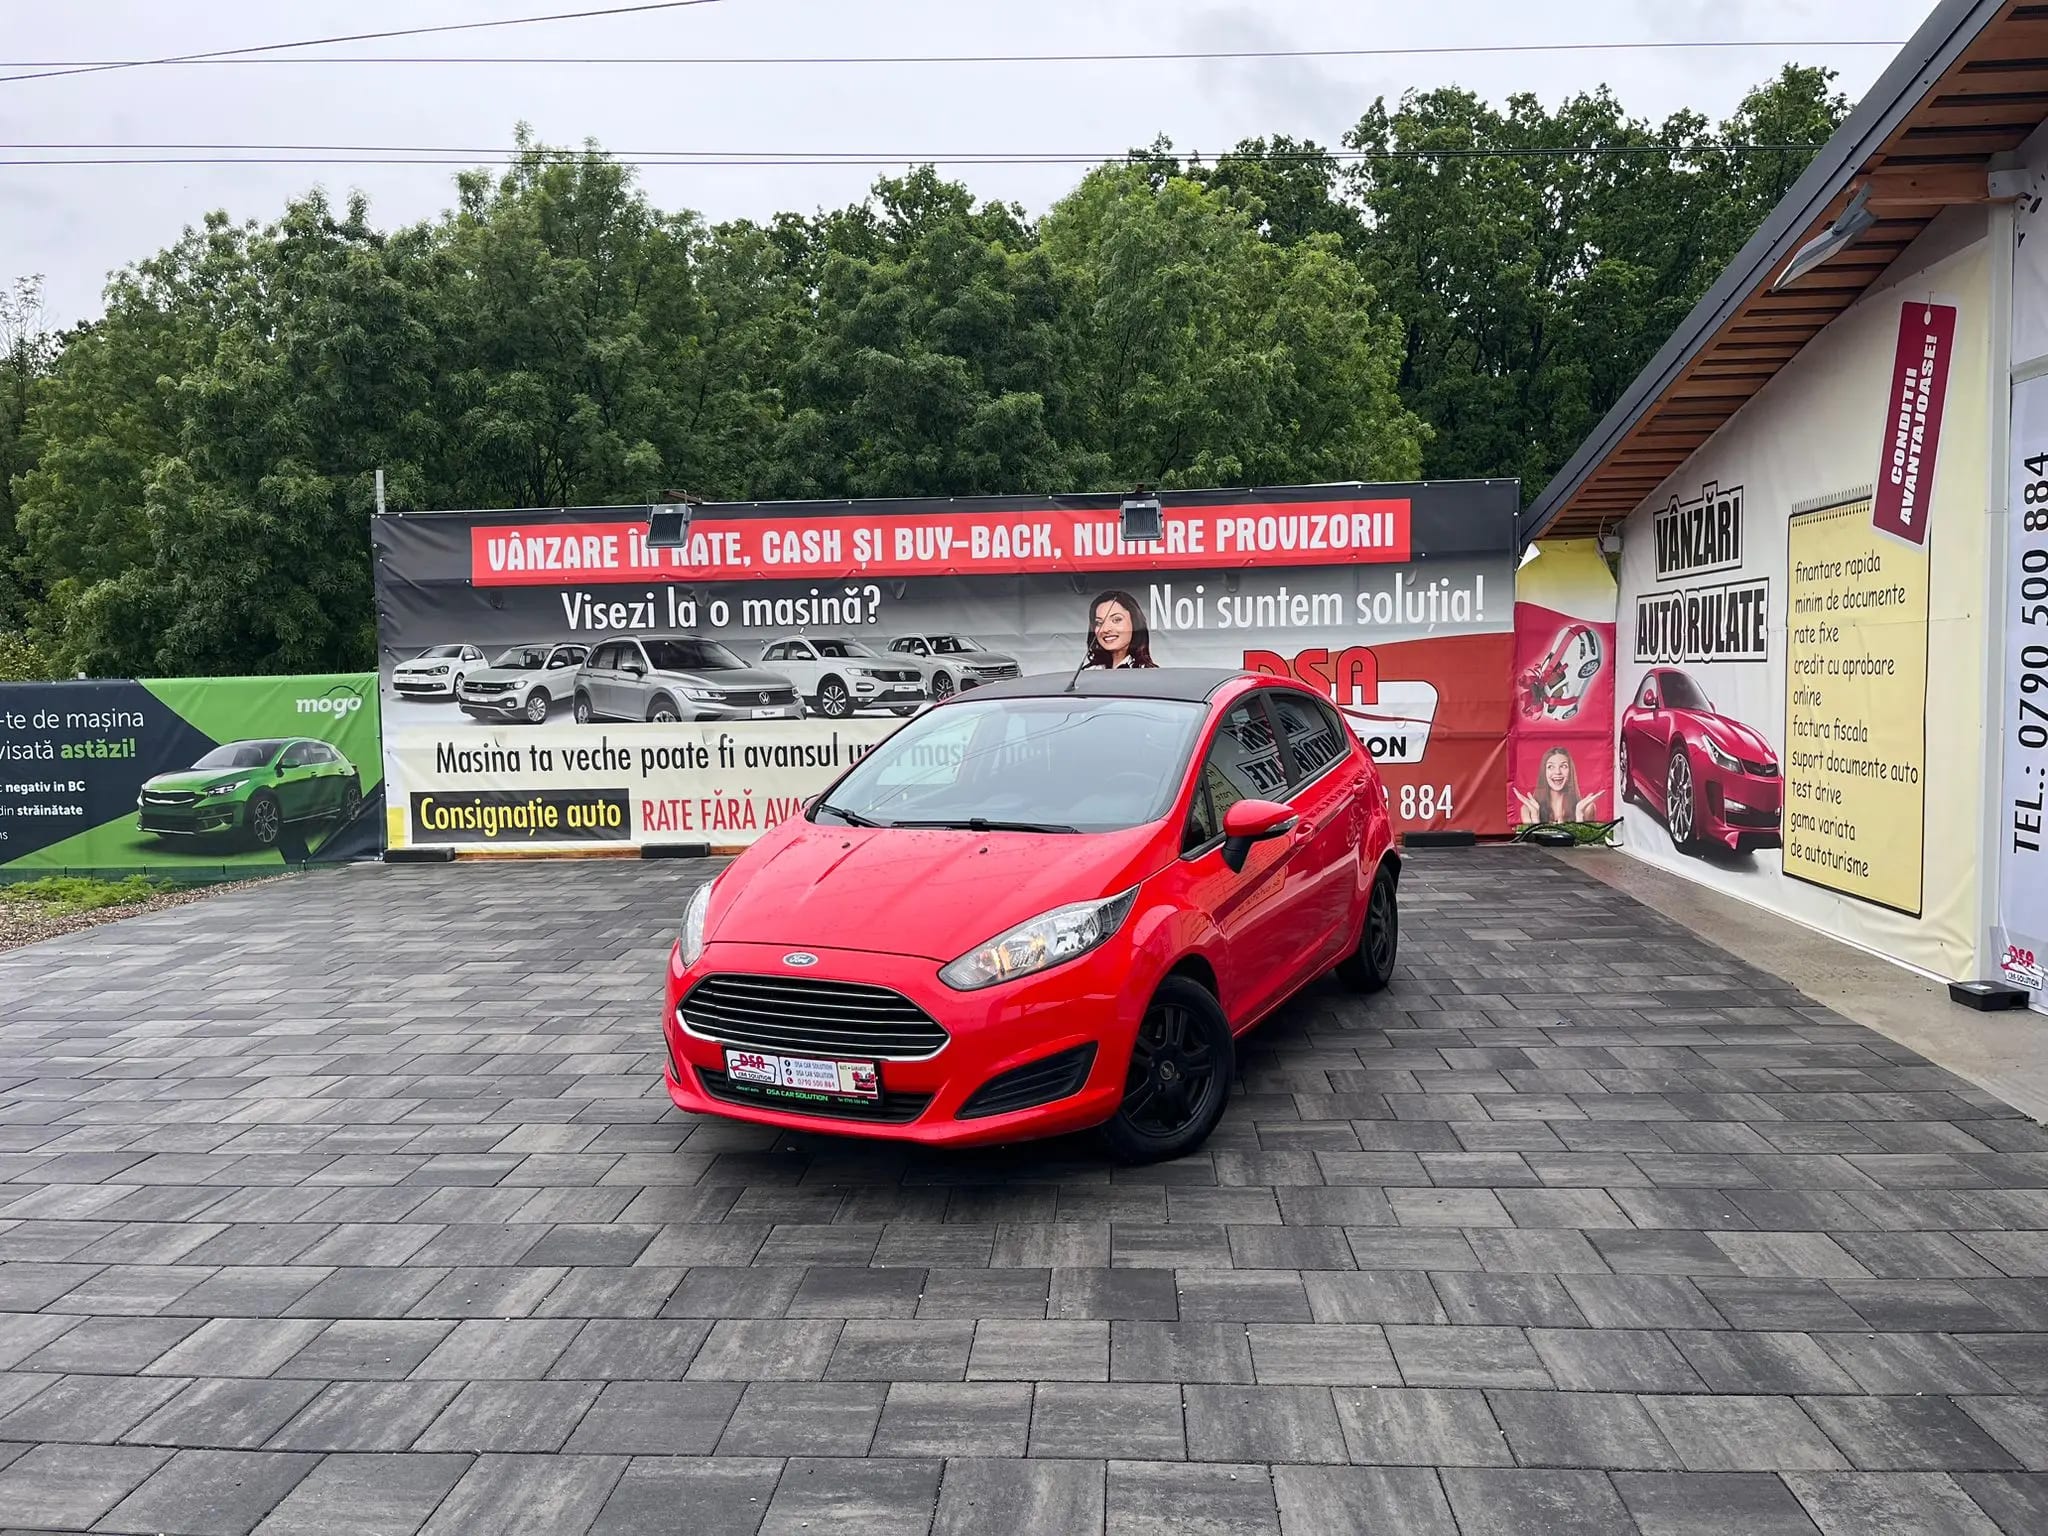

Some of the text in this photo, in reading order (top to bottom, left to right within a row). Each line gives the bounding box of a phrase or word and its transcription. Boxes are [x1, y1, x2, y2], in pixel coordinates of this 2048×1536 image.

[1891, 367, 1918, 484] CONDITII
[1899, 334, 1938, 526] AVANTAJOASE!
[488, 531, 619, 571] VÂNZARE
[762, 529, 841, 565] CASH
[853, 527, 882, 571] ȘI
[895, 523, 1062, 560] BUY-BACK,
[1216, 512, 1394, 552] PROVIZORII
[1656, 490, 1739, 573] VÂNZĂRI
[1795, 549, 1881, 585] finantare rapida
[561, 584, 881, 634] Visezi la o mașină?
[1149, 572, 1484, 633] Noi suntem soluția!
[1795, 584, 1906, 614] minim de documente
[1637, 588, 1765, 656] AUTO RULATE
[1794, 621, 1839, 645] rate fixe
[1794, 652, 1895, 682] credit cu aprobare
[2013, 452, 2048, 854] TEL.: 0790 500 884
[296, 697, 363, 719] mogo
[1793, 684, 1822, 707] online
[33, 709, 60, 729] de
[66, 707, 144, 733] mașina
[1793, 714, 1868, 743] factura fiscala
[61, 738, 136, 759] astăzi!
[529, 744, 553, 772] ta
[562, 736, 631, 771] veche
[641, 741, 709, 778] poate
[719, 733, 734, 769] fi
[744, 731, 839, 768] avansul
[1792, 750, 1918, 784] suport documente auto
[6, 781, 51, 794] negativ
[68, 780, 86, 792] BC
[1400, 784, 1453, 820] 884
[1792, 778, 1842, 805] test drive
[17, 804, 83, 816] străinătate
[420, 797, 622, 837] Consignație auto
[642, 799, 693, 831] RATE
[701, 788, 757, 830] FĂRĂ
[1791, 812, 1856, 841] gama variata
[1791, 836, 1869, 877] de autoturisme
[739, 1054, 765, 1069] DSA
[766, 1088, 780, 1096] DSA
[795, 1092, 829, 1101] SOLUTION
